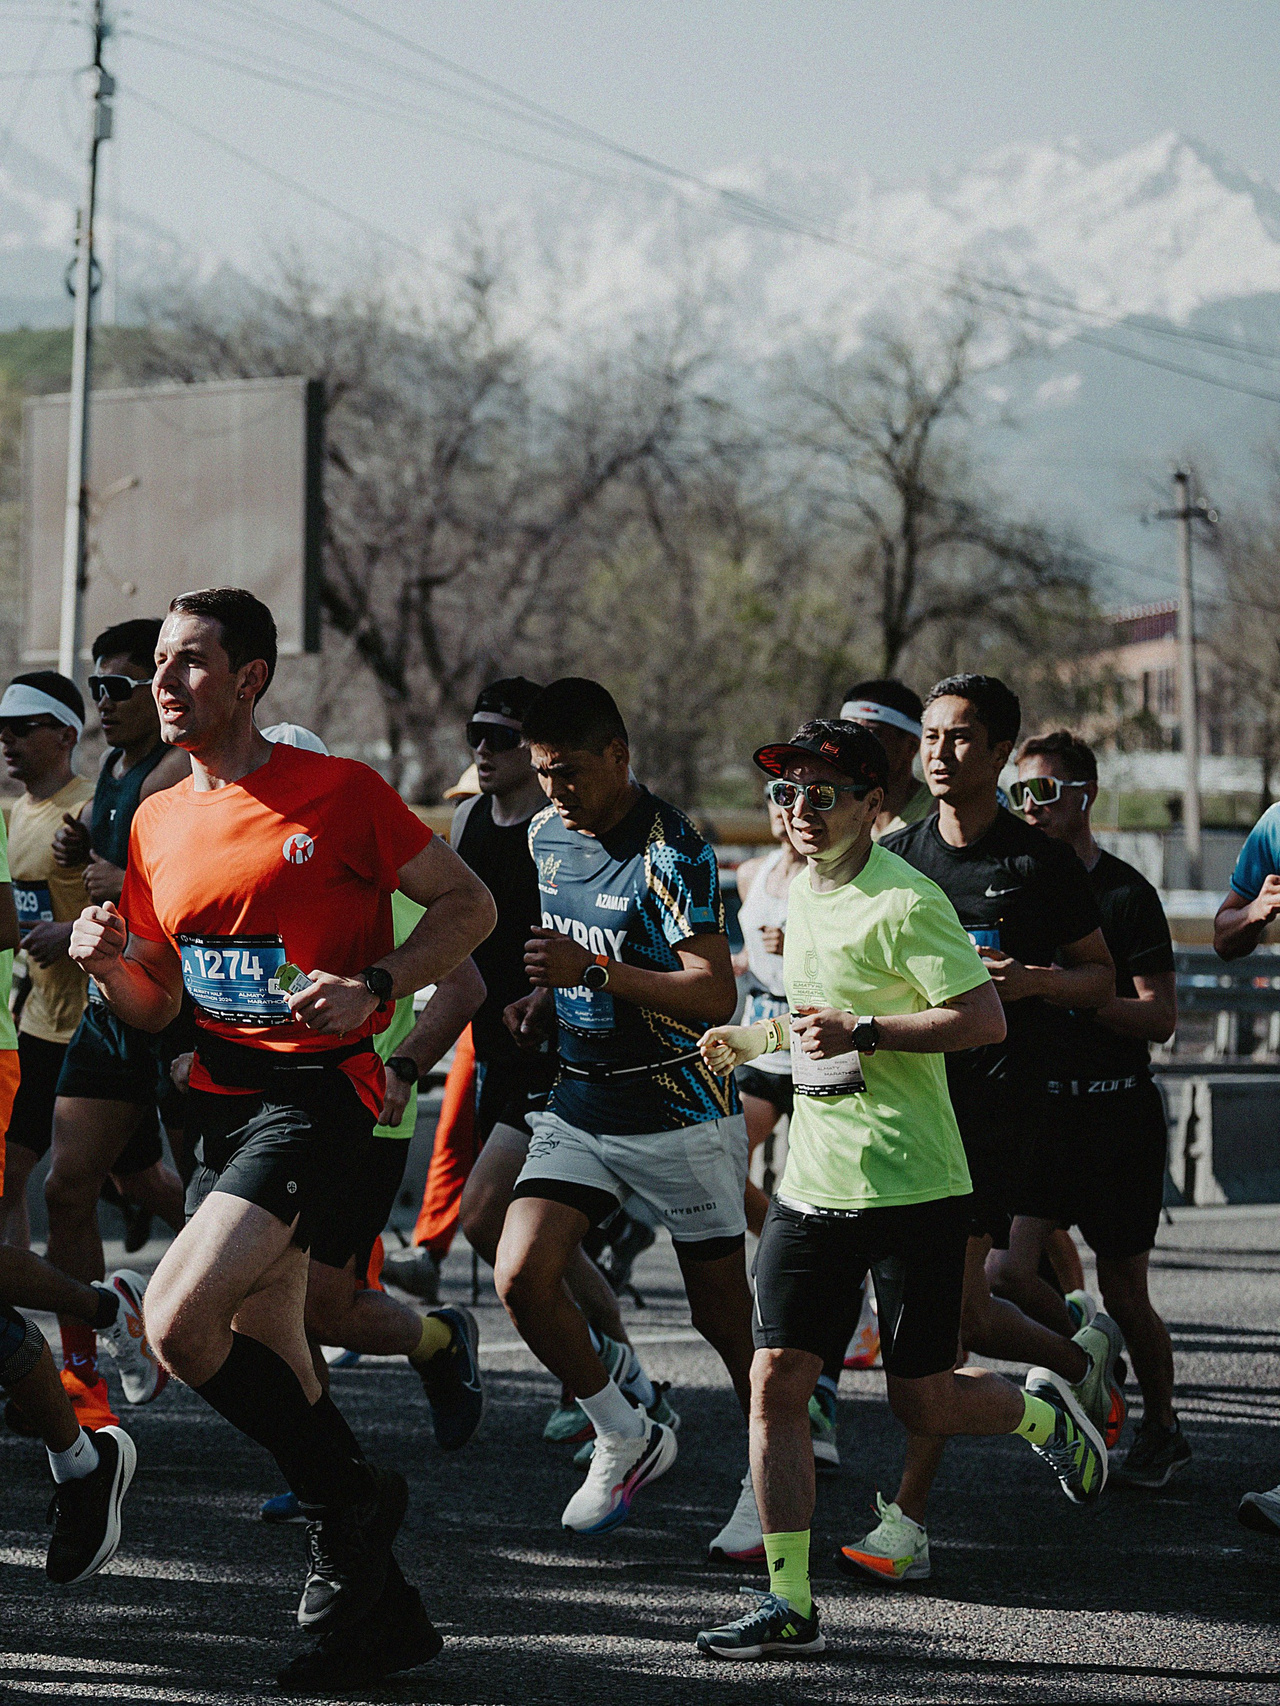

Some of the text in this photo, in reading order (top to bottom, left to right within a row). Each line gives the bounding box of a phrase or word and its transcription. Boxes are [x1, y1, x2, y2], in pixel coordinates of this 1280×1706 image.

[595, 893, 630, 912] AZAMAT
[183, 948, 264, 981] A 1274
[823, 1069, 861, 1077] MARATHON
